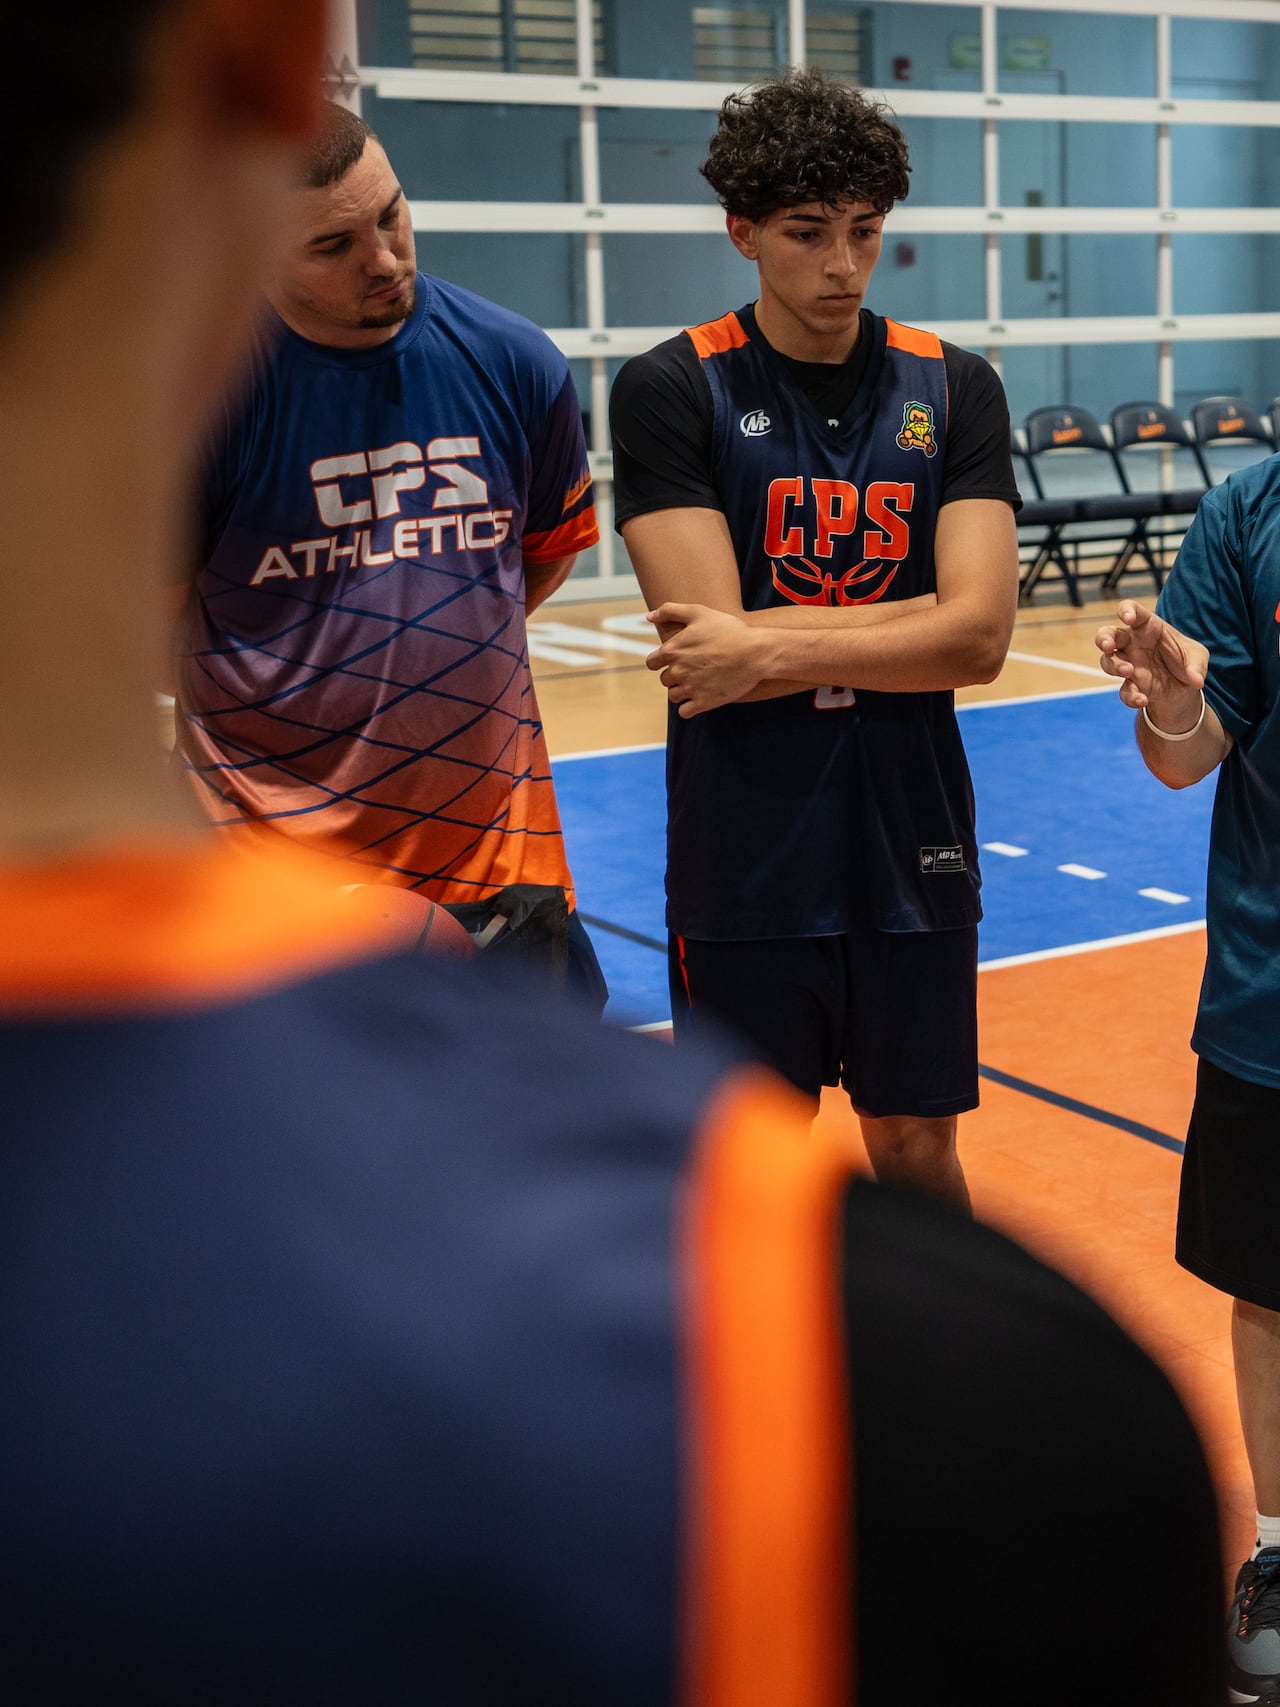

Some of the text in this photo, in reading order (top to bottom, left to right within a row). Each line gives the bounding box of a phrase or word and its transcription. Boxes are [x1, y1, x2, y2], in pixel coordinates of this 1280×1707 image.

[310, 436, 488, 528] CPS
[764, 476, 914, 561] CPS
[248, 510, 513, 586] ATHLETICS
